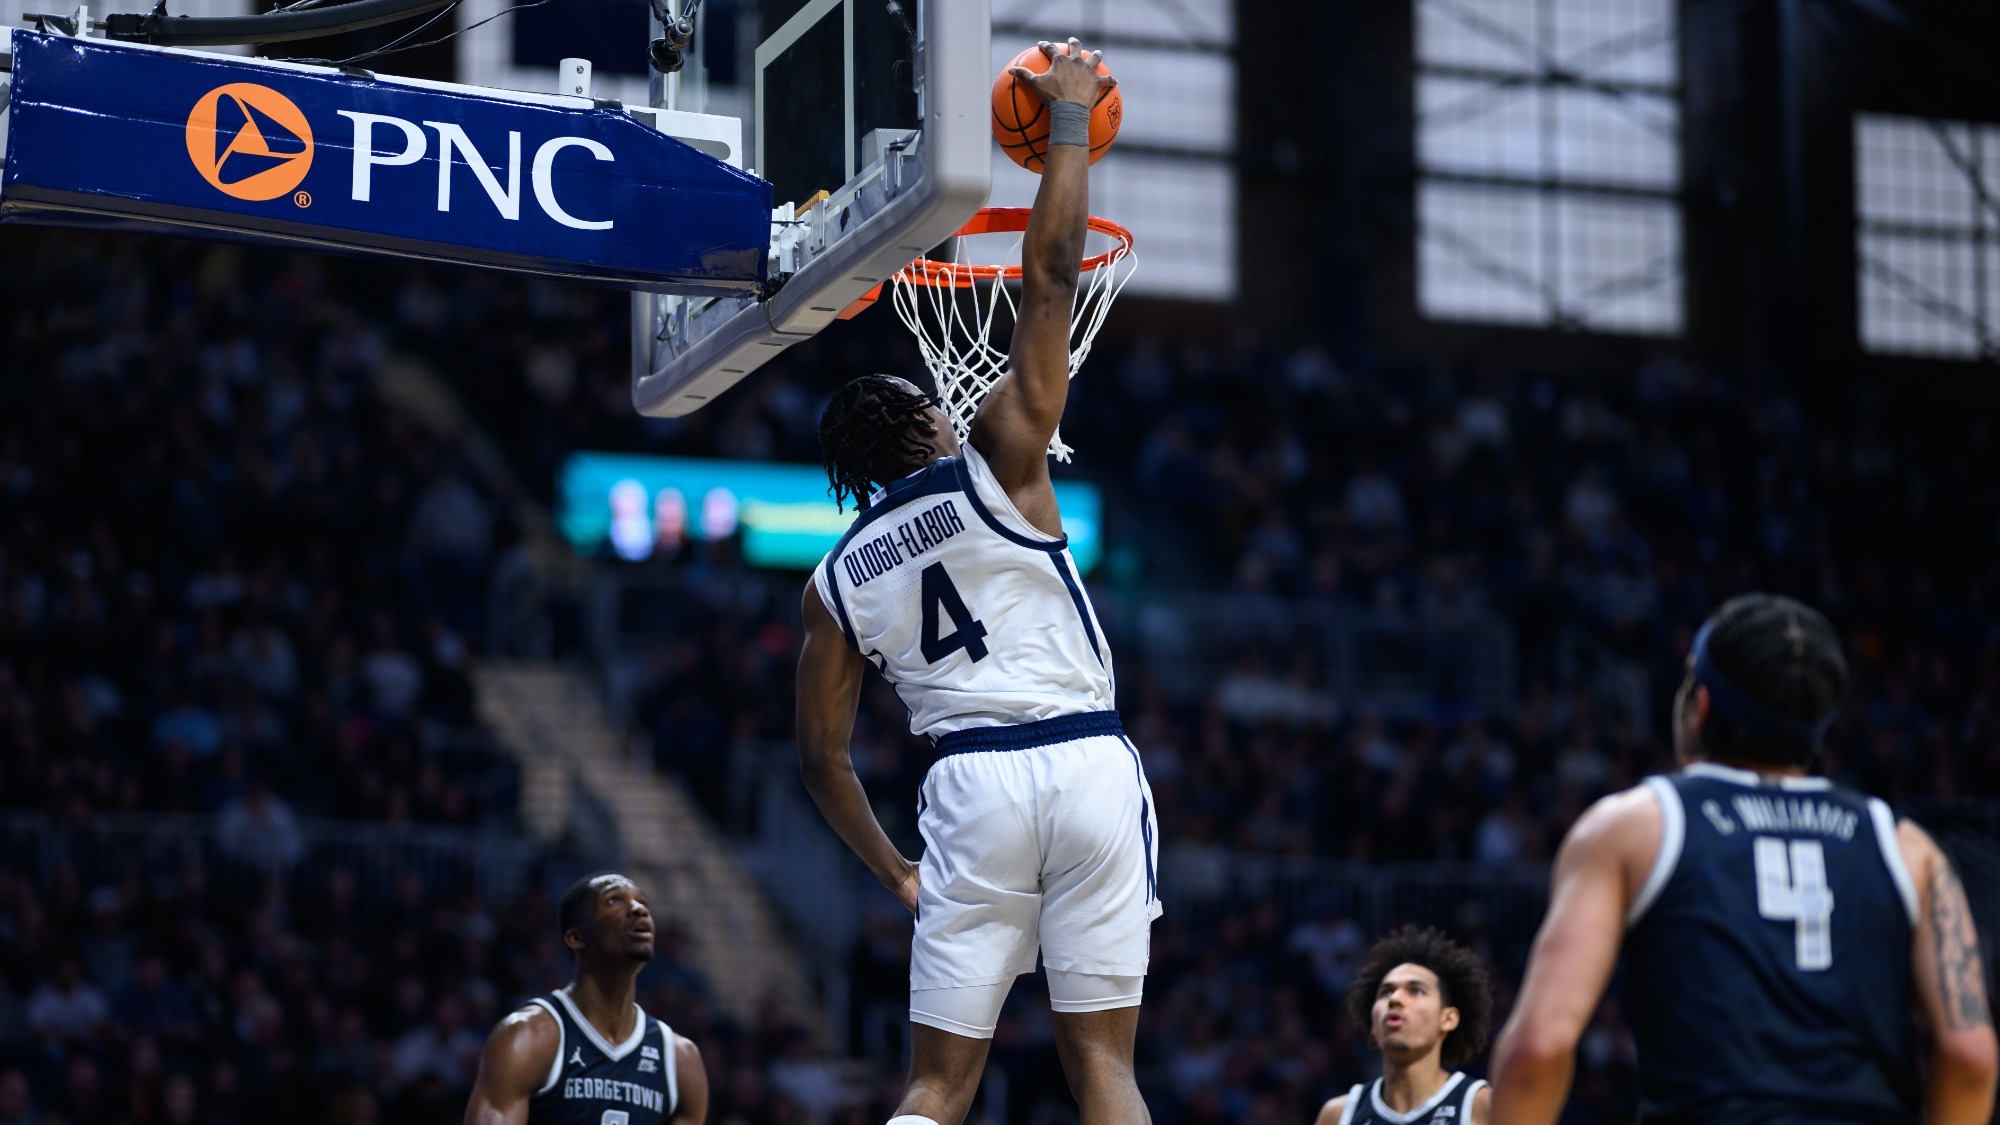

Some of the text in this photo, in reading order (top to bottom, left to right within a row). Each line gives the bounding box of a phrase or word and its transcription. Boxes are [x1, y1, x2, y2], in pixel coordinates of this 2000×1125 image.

[337, 110, 614, 231] PNC
[844, 500, 966, 587] OLIOGU-ELABOR
[921, 561, 989, 665] 4
[1753, 837, 1834, 971] 4
[564, 1078, 664, 1113] GEORGETOWN
